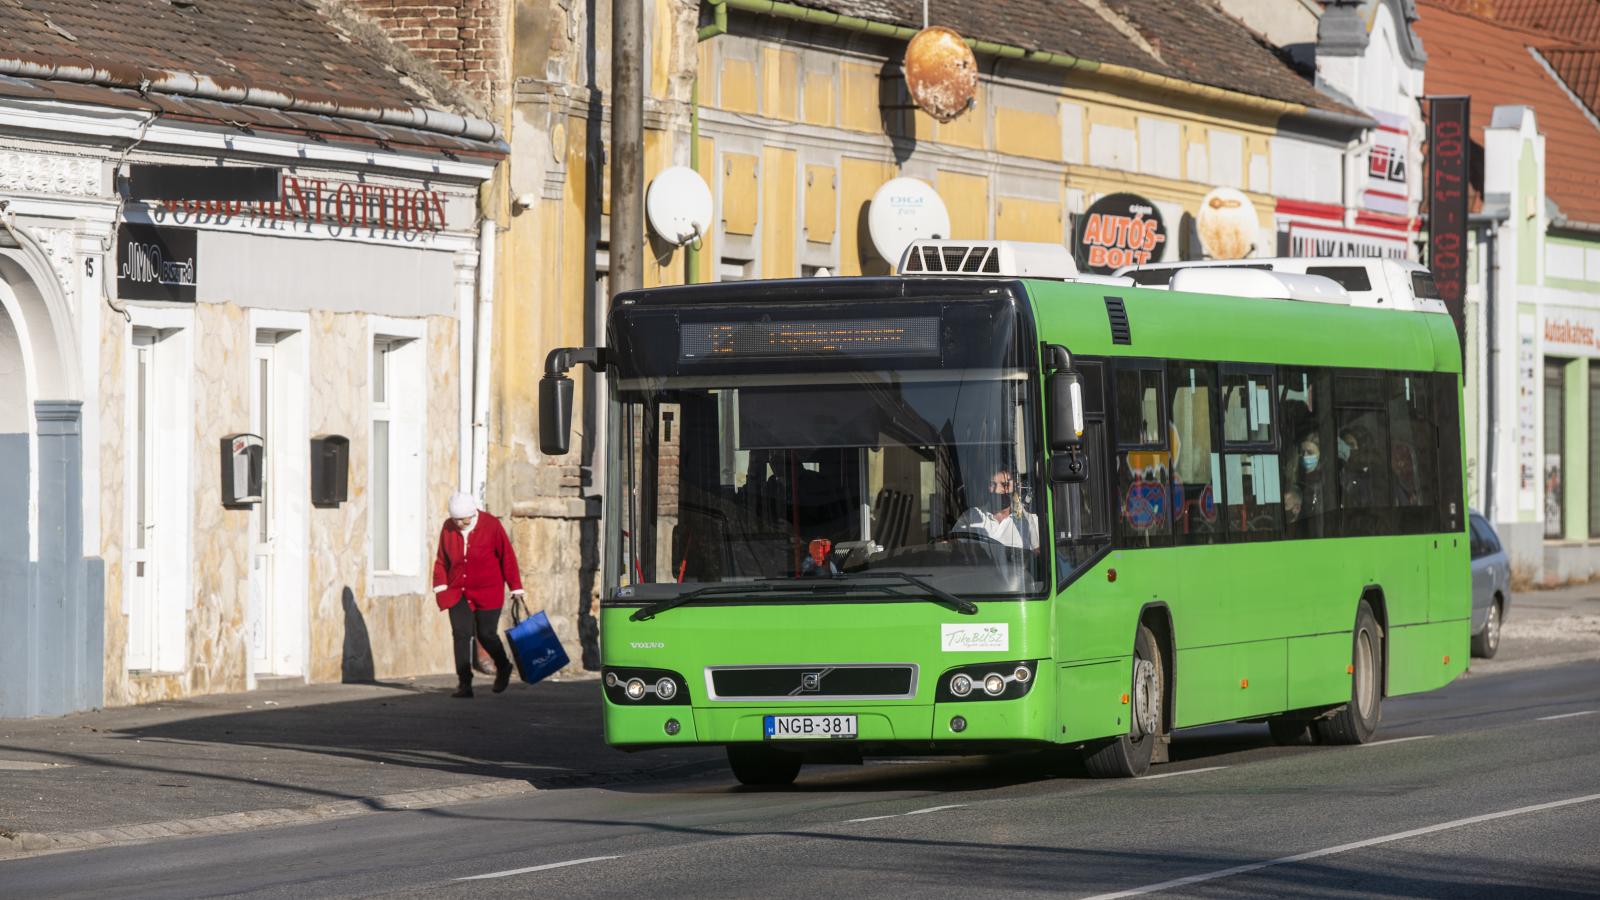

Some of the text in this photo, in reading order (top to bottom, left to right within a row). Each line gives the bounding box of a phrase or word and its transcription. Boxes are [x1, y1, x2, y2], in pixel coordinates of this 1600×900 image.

[1436, 120, 1462, 201] 17:00
[335, 182, 447, 233] OTTHON
[1083, 213, 1165, 251] AUTÓS-
[84, 257, 94, 278] 15
[778, 717, 851, 733] NGB-381
